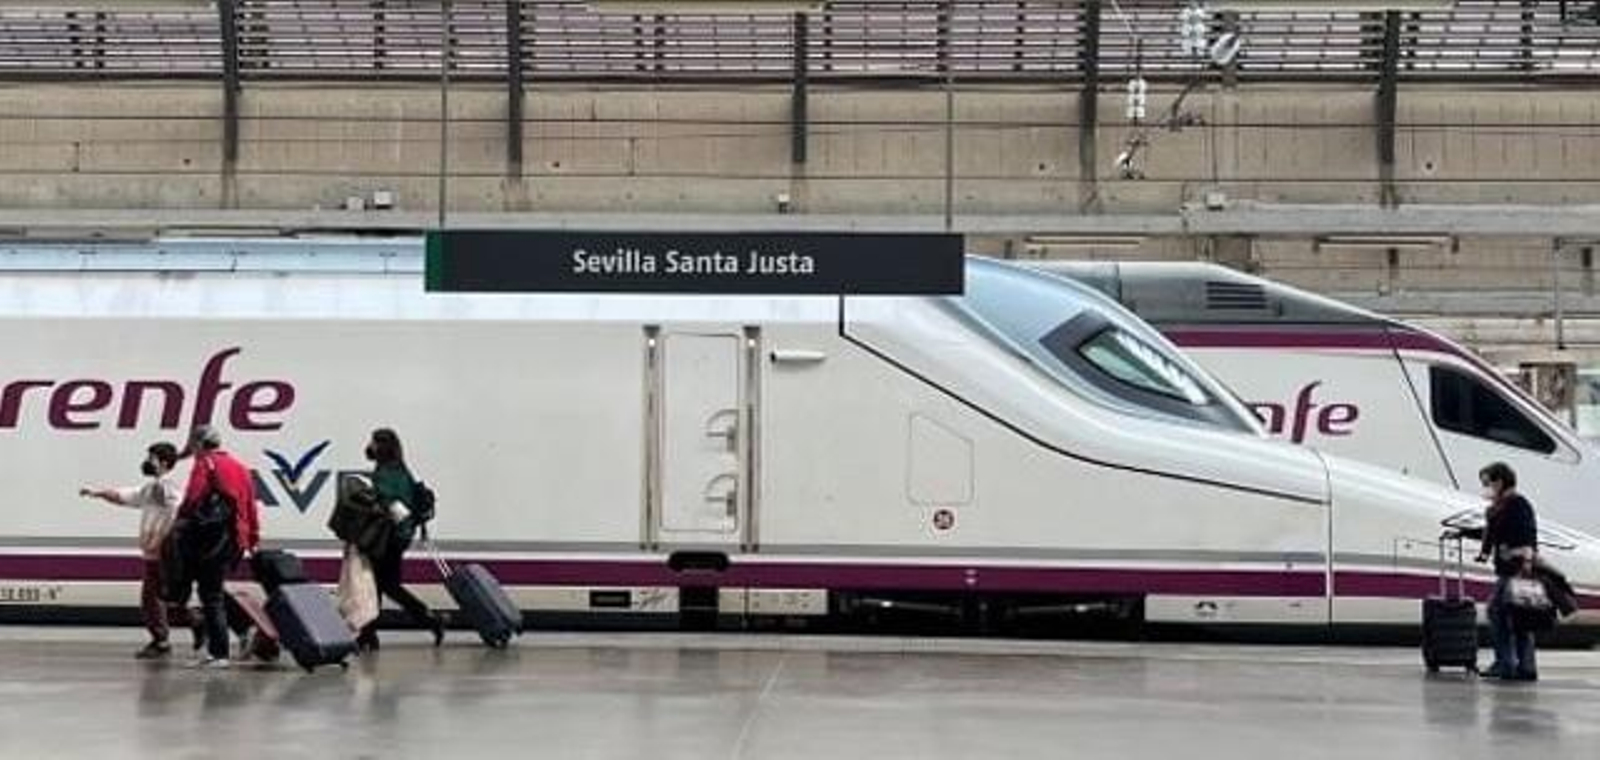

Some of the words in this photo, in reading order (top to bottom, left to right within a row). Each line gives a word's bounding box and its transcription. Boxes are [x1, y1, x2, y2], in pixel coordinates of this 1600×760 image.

[573, 249, 656, 273] Sevilla
[665, 251, 738, 273] Santa
[747, 251, 815, 274] Justa
[0, 346, 295, 459] renfe
[1249, 380, 1359, 444] nfe
